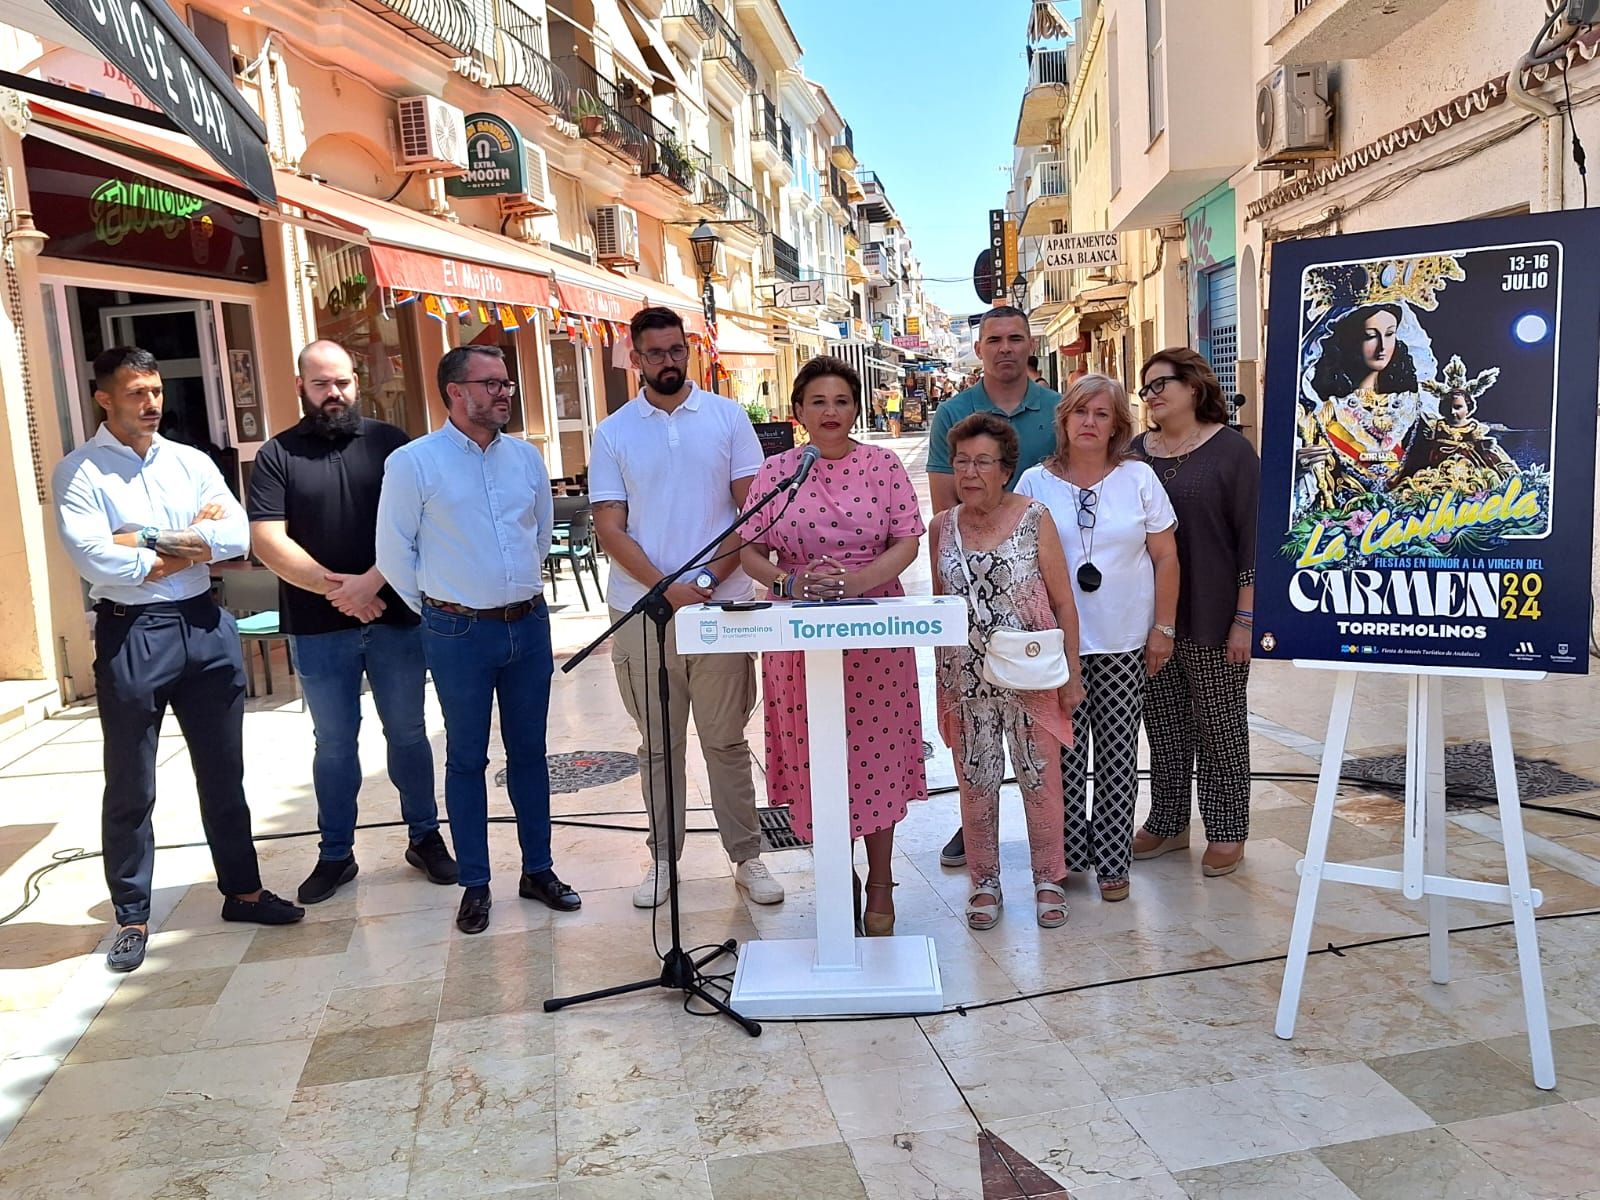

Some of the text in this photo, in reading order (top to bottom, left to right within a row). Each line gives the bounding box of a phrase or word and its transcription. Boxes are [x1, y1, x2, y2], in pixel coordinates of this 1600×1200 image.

[180, 57, 233, 156] BAR
[473, 160, 497, 169] EXTRA
[460, 168, 511, 183] SMOOTH
[1046, 233, 1118, 252] APARTAMENTOS
[993, 212, 1003, 297] La Cigala
[1046, 249, 1118, 267] CASA BLANCA
[1509, 253, 1549, 271] 13-16
[442, 259, 503, 298] El Mojito
[1502, 271, 1548, 291] JULIO
[1296, 476, 1541, 568] La Carihuela
[1374, 557, 1544, 570] FIESTAS EN HONOR A LA VIRGEN DEL
[1288, 569, 1500, 619] CARMEN
[1503, 572, 1543, 597] 20
[1500, 596, 1542, 620] 24
[722, 625, 773, 634] Torremolinos
[789, 616, 943, 640] Torremolinos
[1337, 621, 1488, 640] TORREMOLINOS
